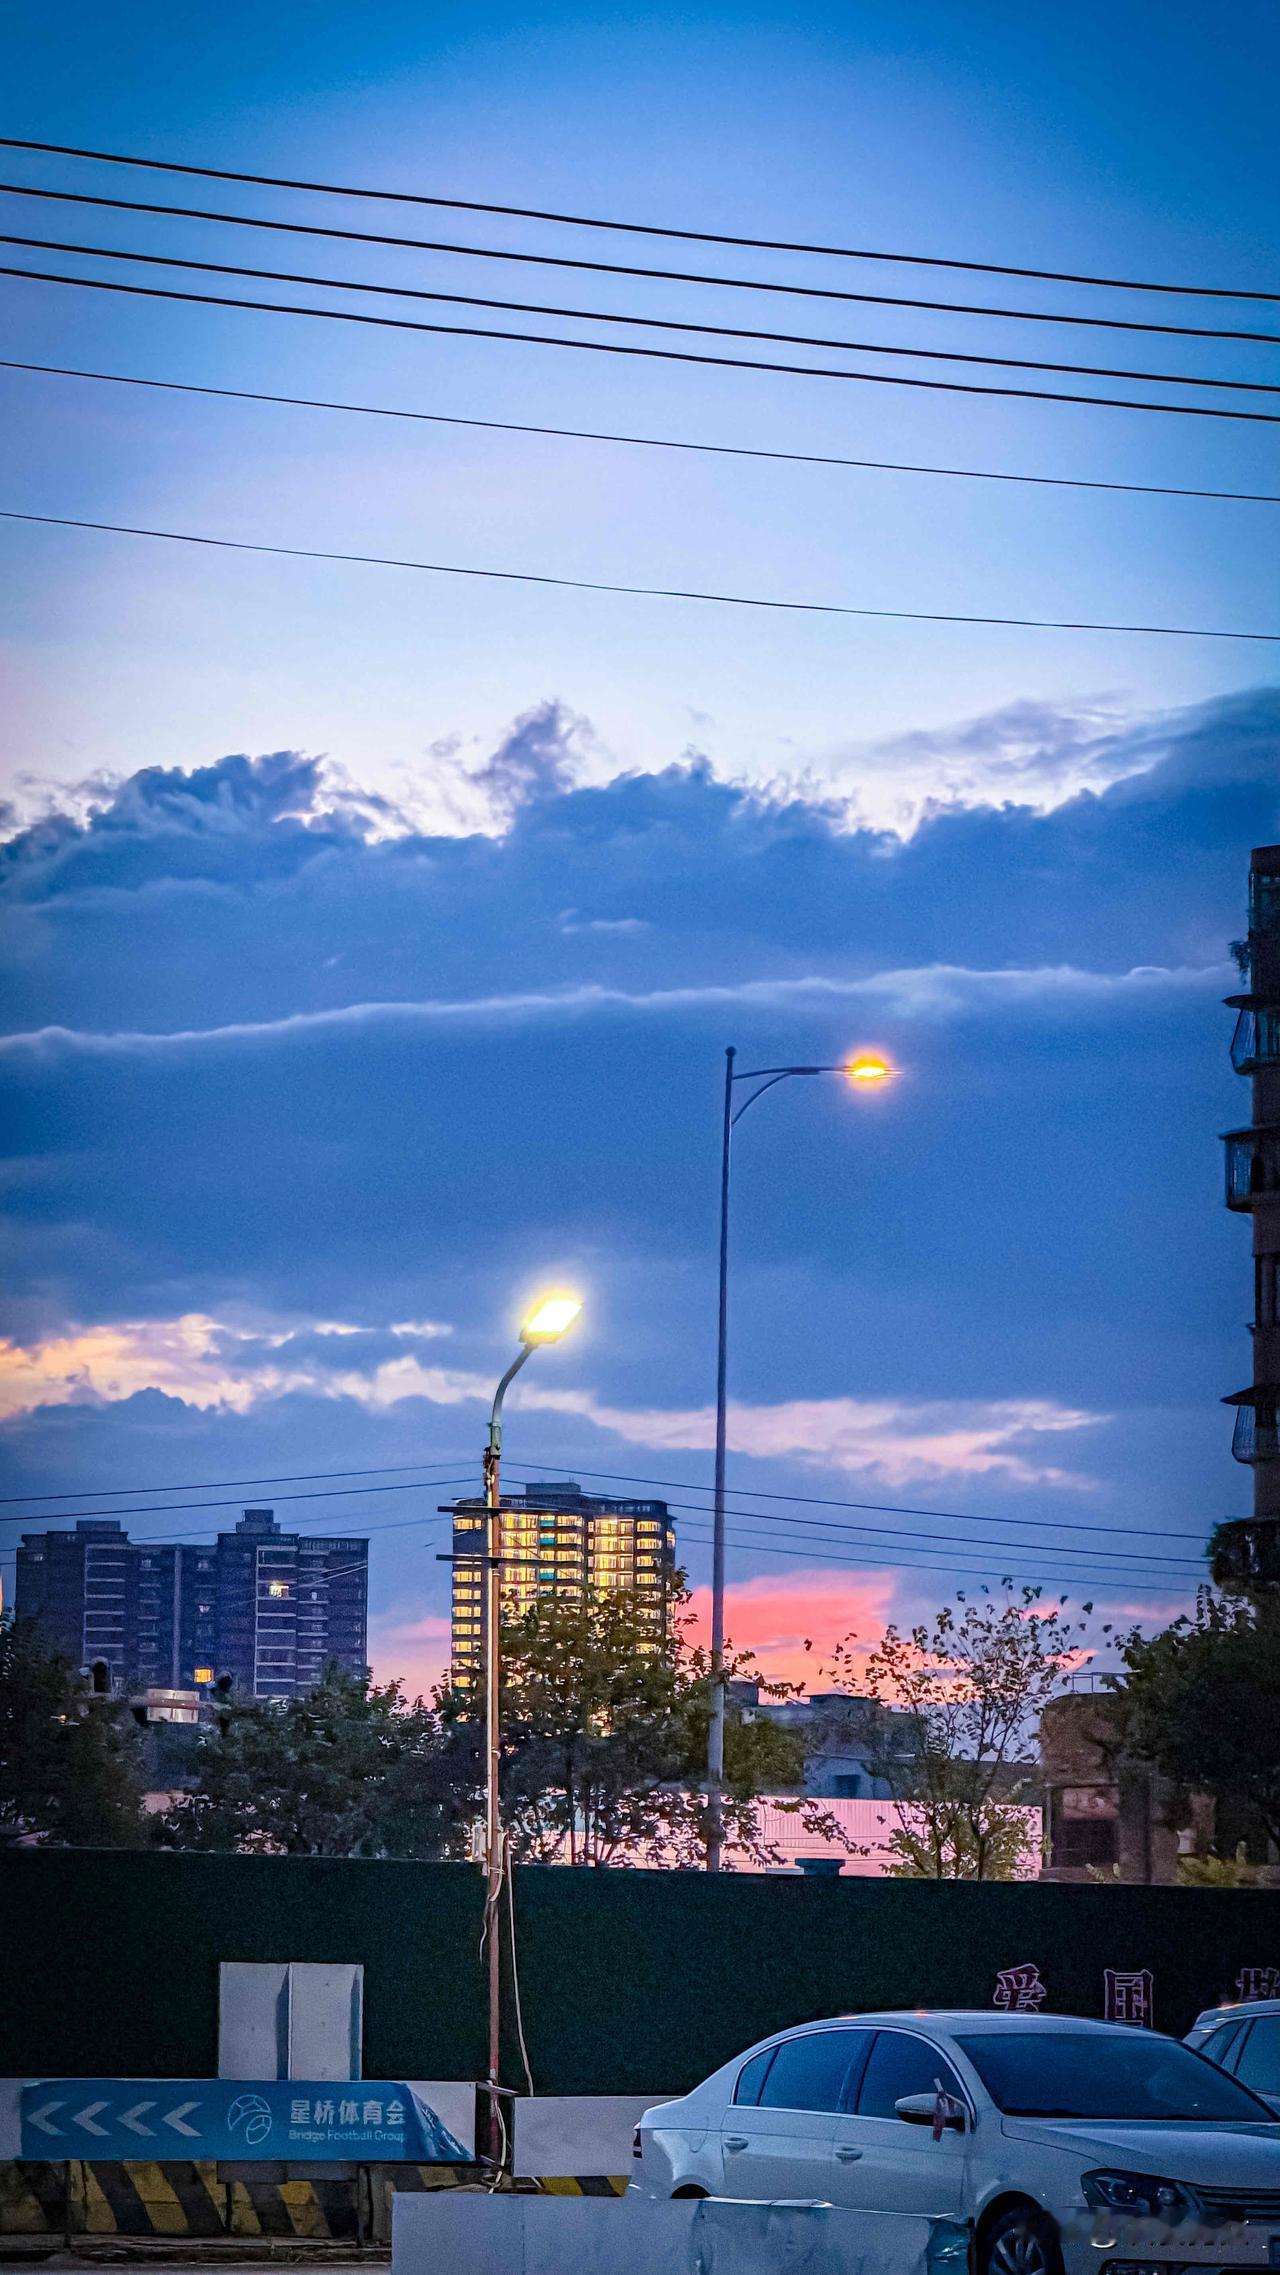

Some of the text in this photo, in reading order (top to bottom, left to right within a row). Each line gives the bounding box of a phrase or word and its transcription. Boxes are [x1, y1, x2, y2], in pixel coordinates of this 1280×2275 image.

[290, 2099, 406, 2125] 星桥体育会
[288, 2129, 326, 2143] Bridge
[327, 2129, 373, 2141] Football
